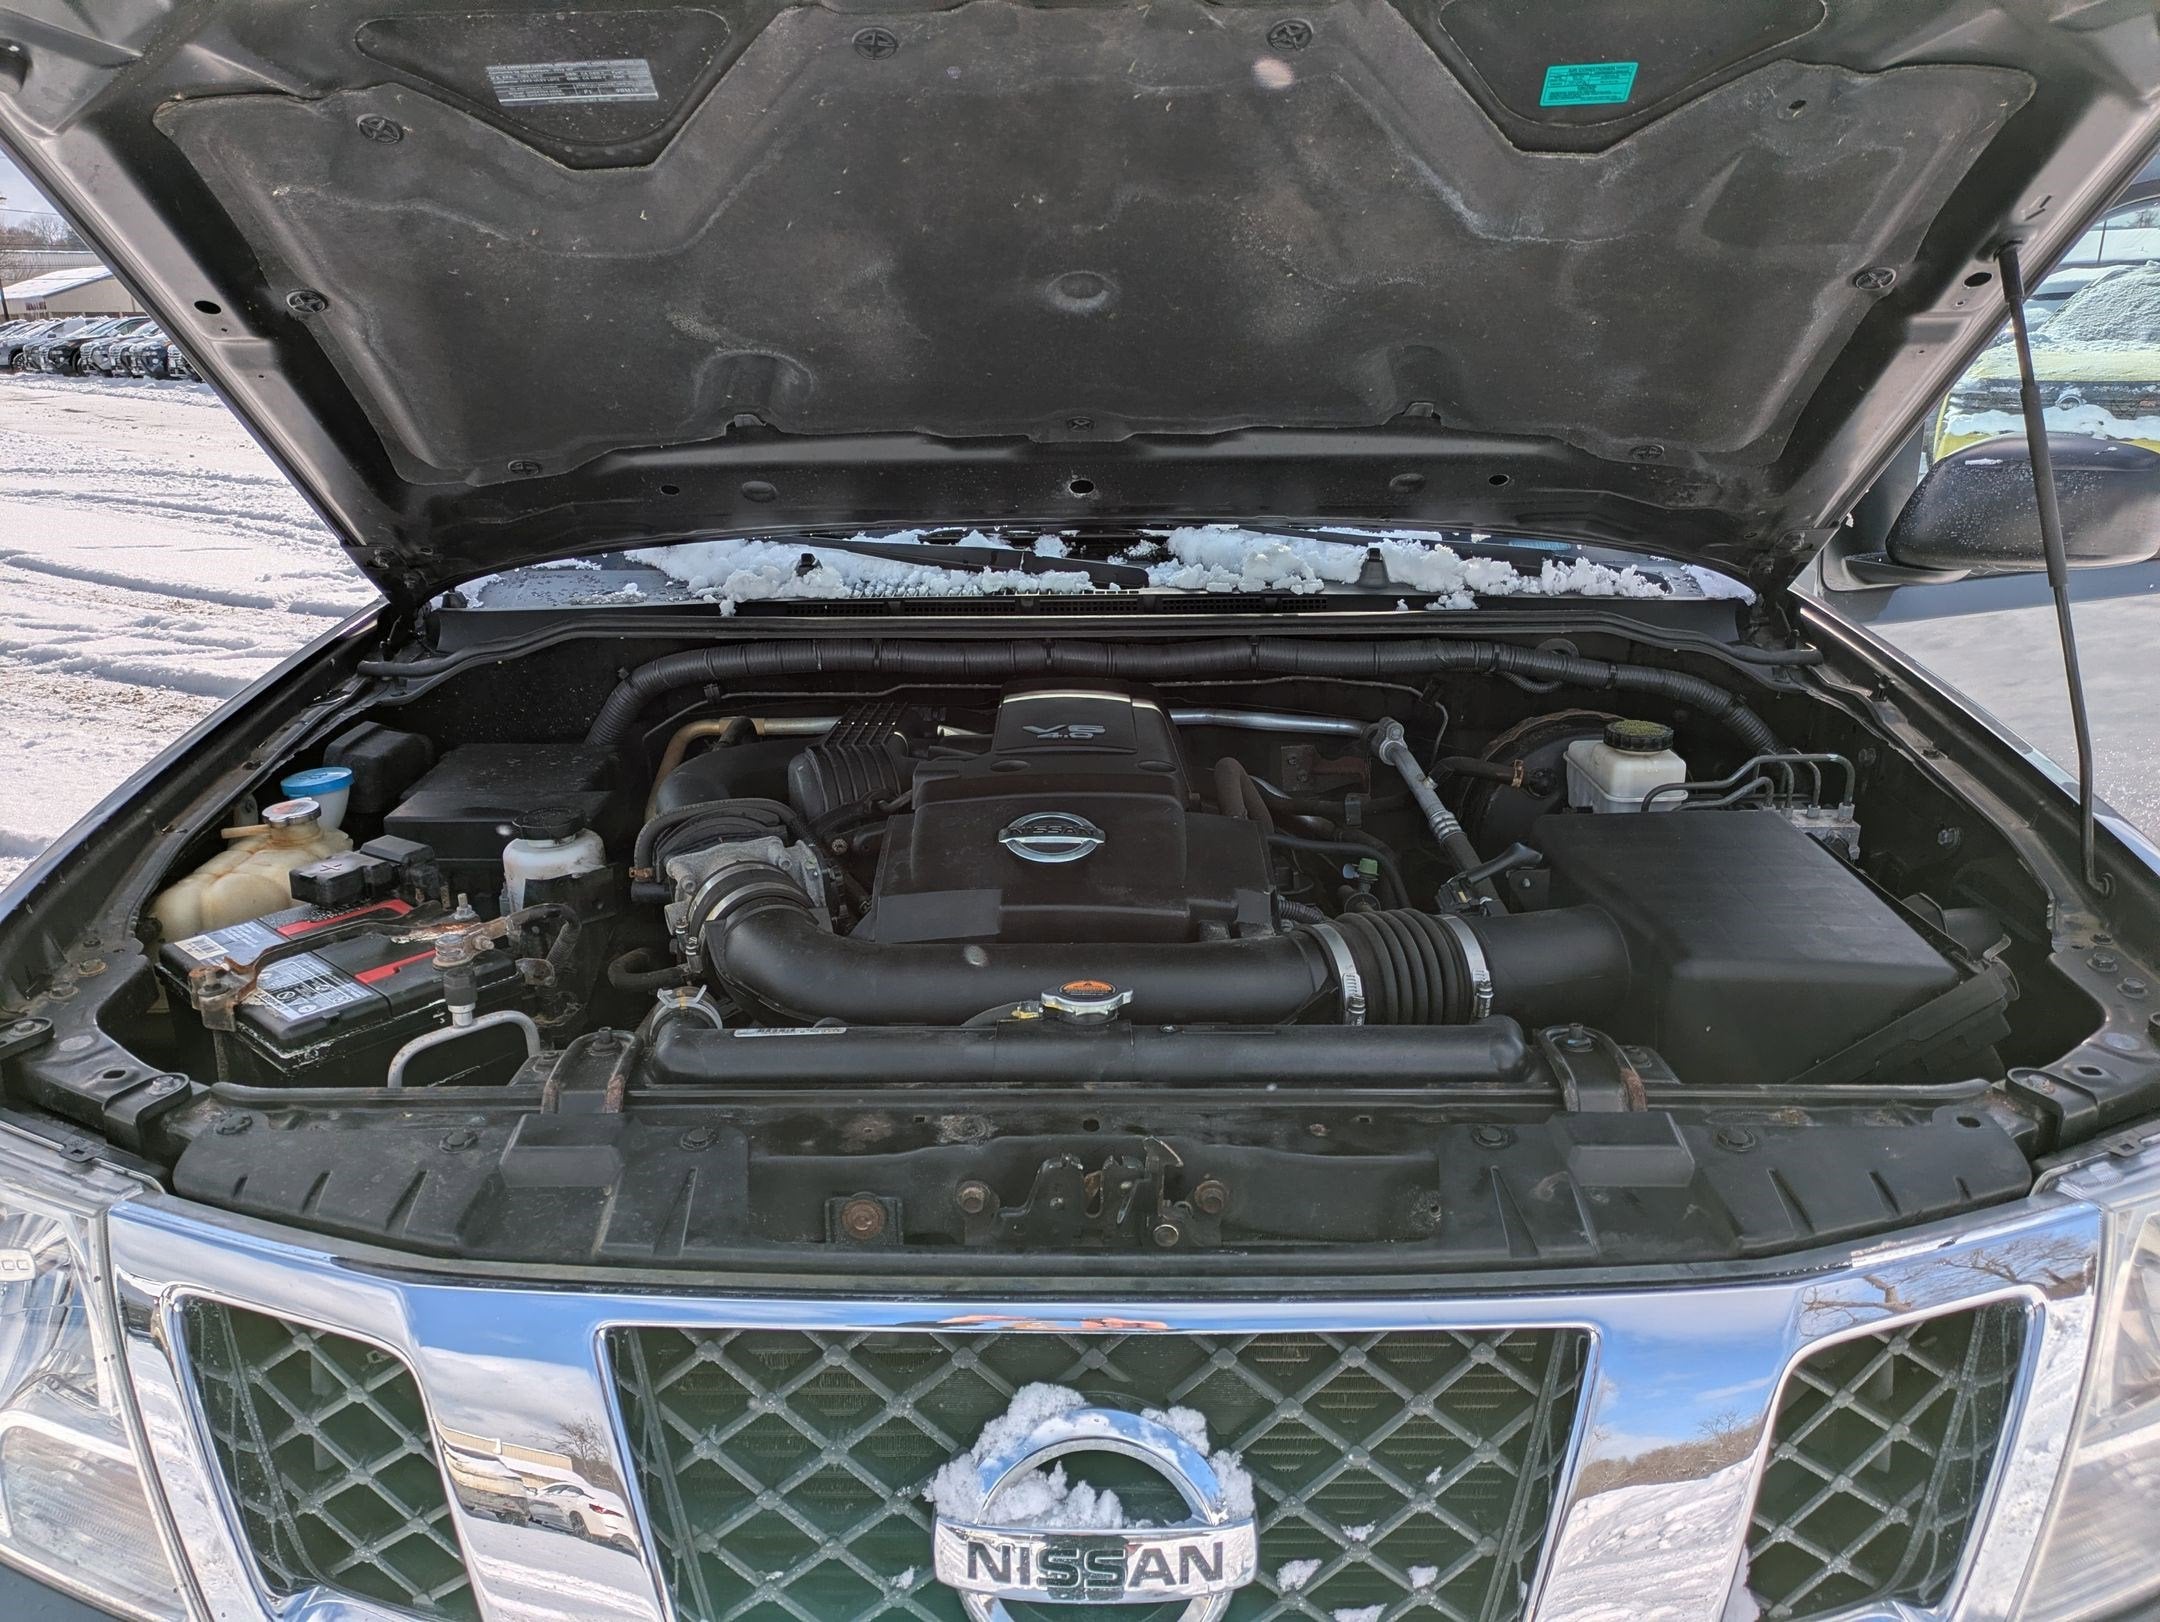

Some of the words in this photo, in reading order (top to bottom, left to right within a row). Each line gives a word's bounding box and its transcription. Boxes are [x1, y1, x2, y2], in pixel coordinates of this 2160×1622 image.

[1022, 724, 1106, 734] V6
[1007, 825, 1097, 836] NISSAN
[966, 1540, 1224, 1588] NISSAN
